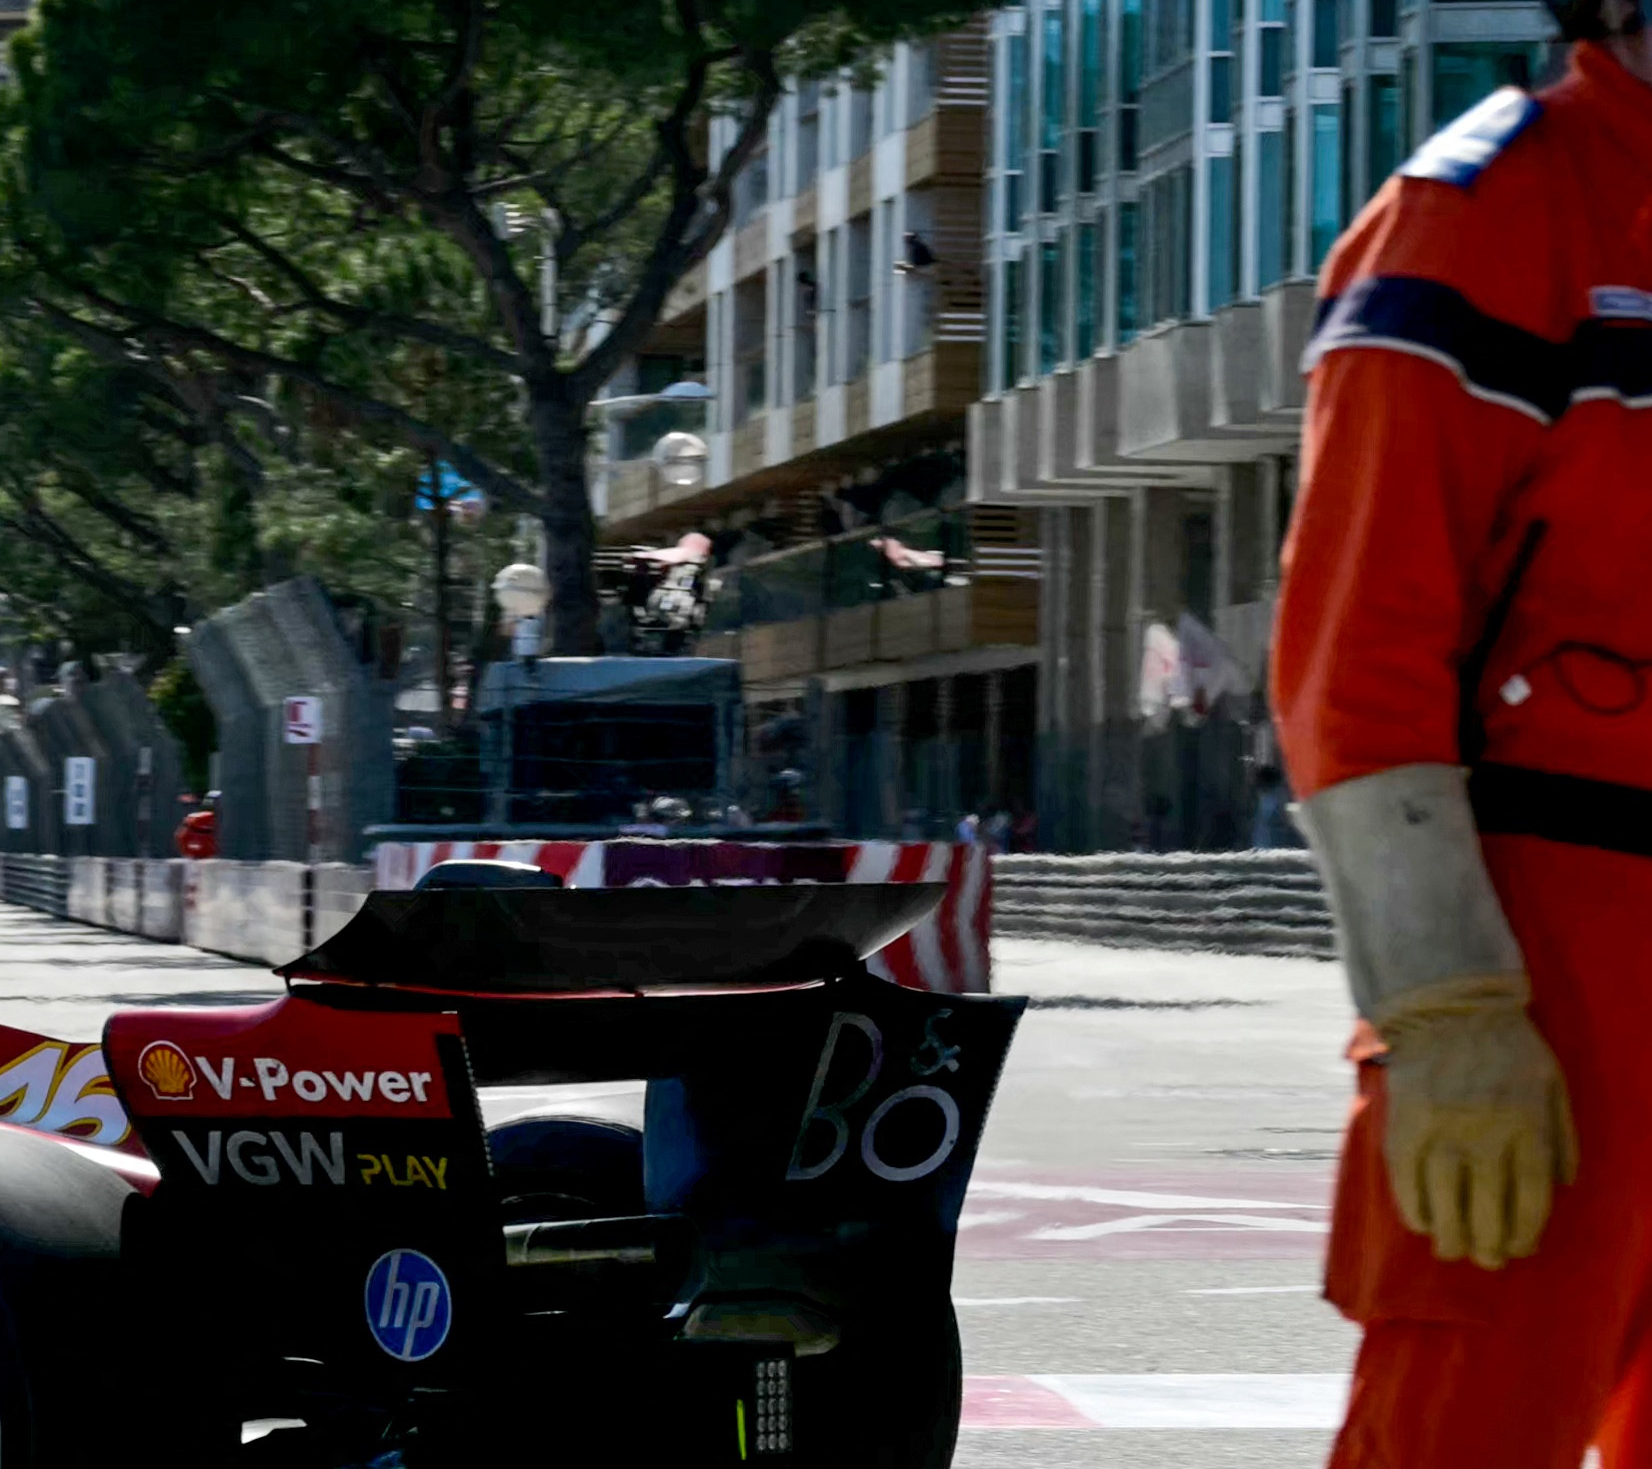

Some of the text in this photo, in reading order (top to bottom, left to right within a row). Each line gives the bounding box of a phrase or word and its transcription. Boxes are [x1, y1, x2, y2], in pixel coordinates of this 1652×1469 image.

[194, 1056, 433, 1104] V-Power
[171, 1130, 449, 1190] VGW PLAY
[377, 1250, 440, 1359] hp
